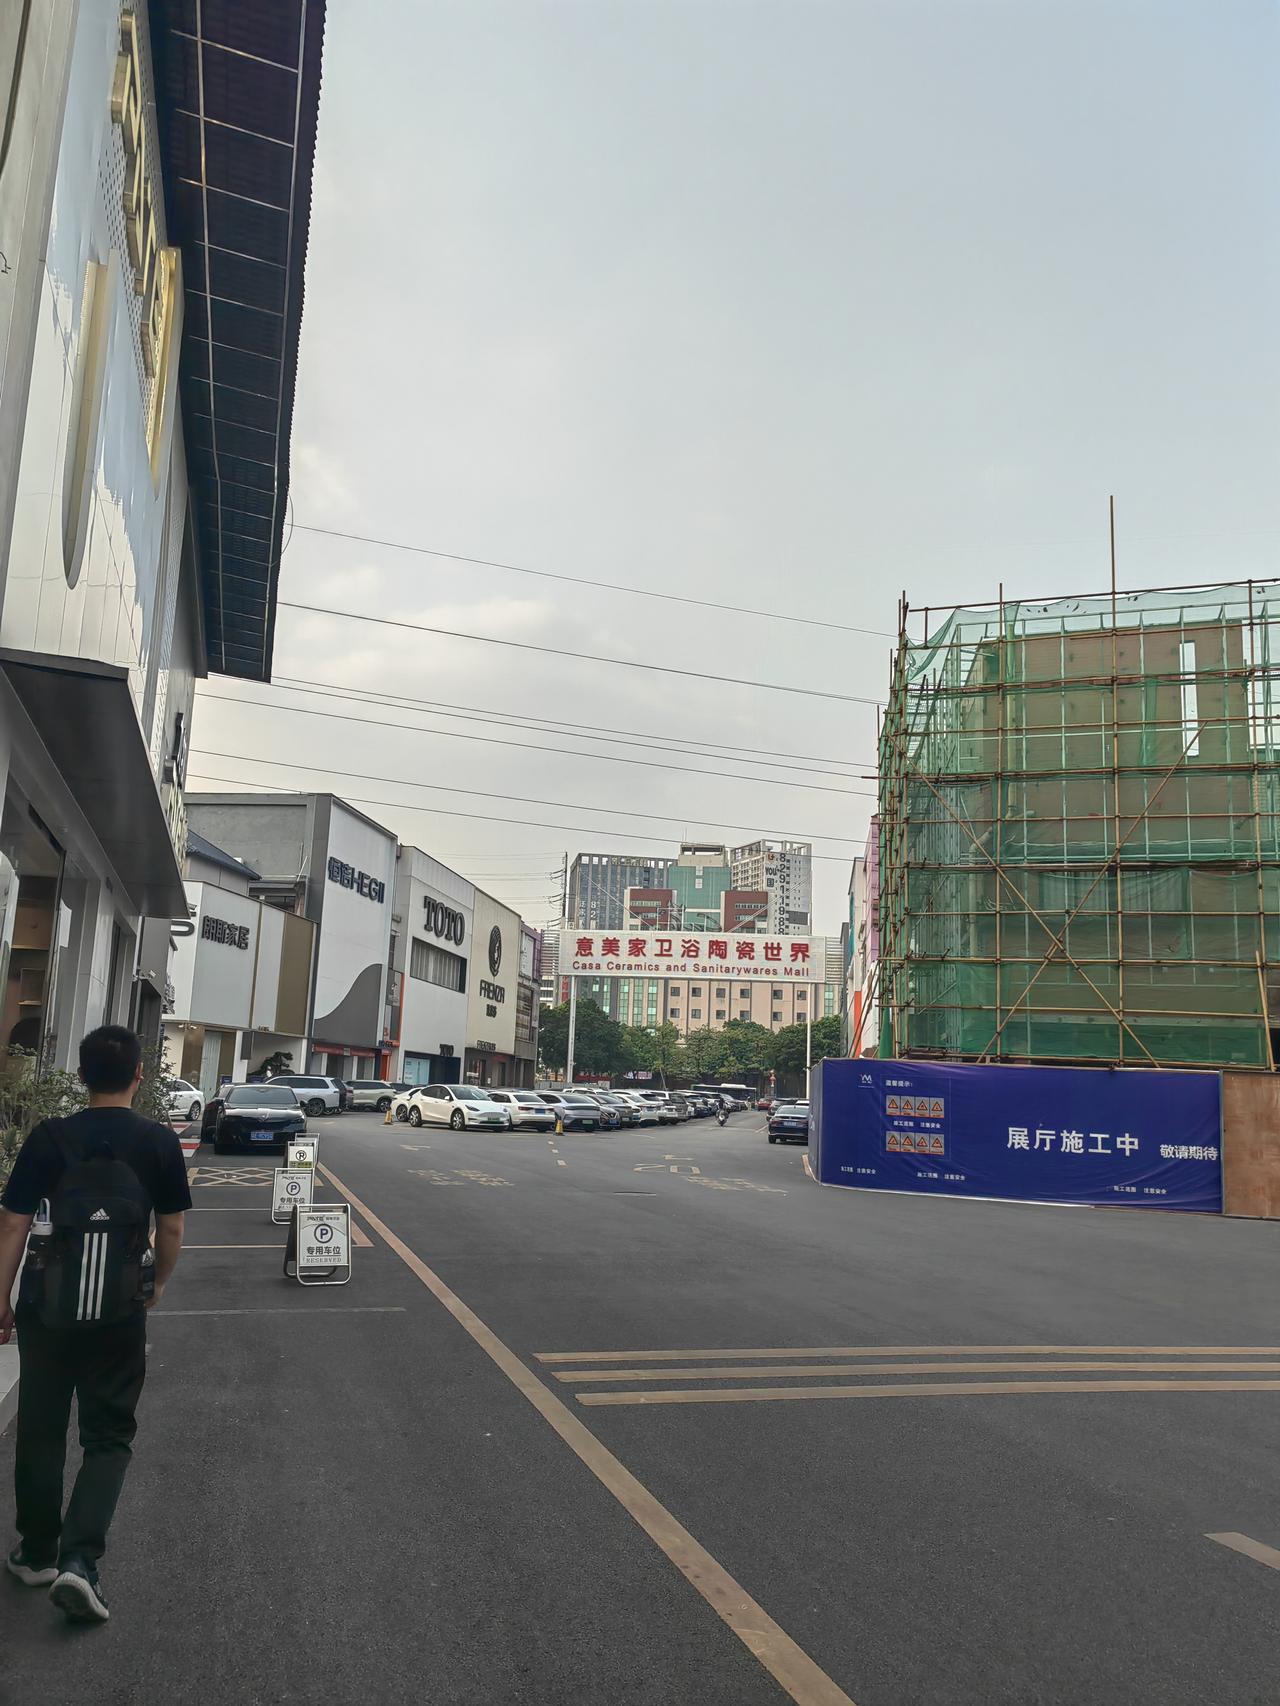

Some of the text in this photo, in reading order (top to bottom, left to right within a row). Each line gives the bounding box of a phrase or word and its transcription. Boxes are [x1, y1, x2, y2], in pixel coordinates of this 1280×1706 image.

[201, 915, 250, 950] 朗斯家居
[424, 895, 465, 946] TOTO
[575, 937, 810, 962] 意美家卫浴陶瓷世界
[573, 961, 809, 976] Casa Ceramics and Sanitarywares Mall
[1007, 1127, 1139, 1157] 展厅施工中
[1160, 1144, 1219, 1161] 敬请期待
[306, 1246, 341, 1254] 专用车位
